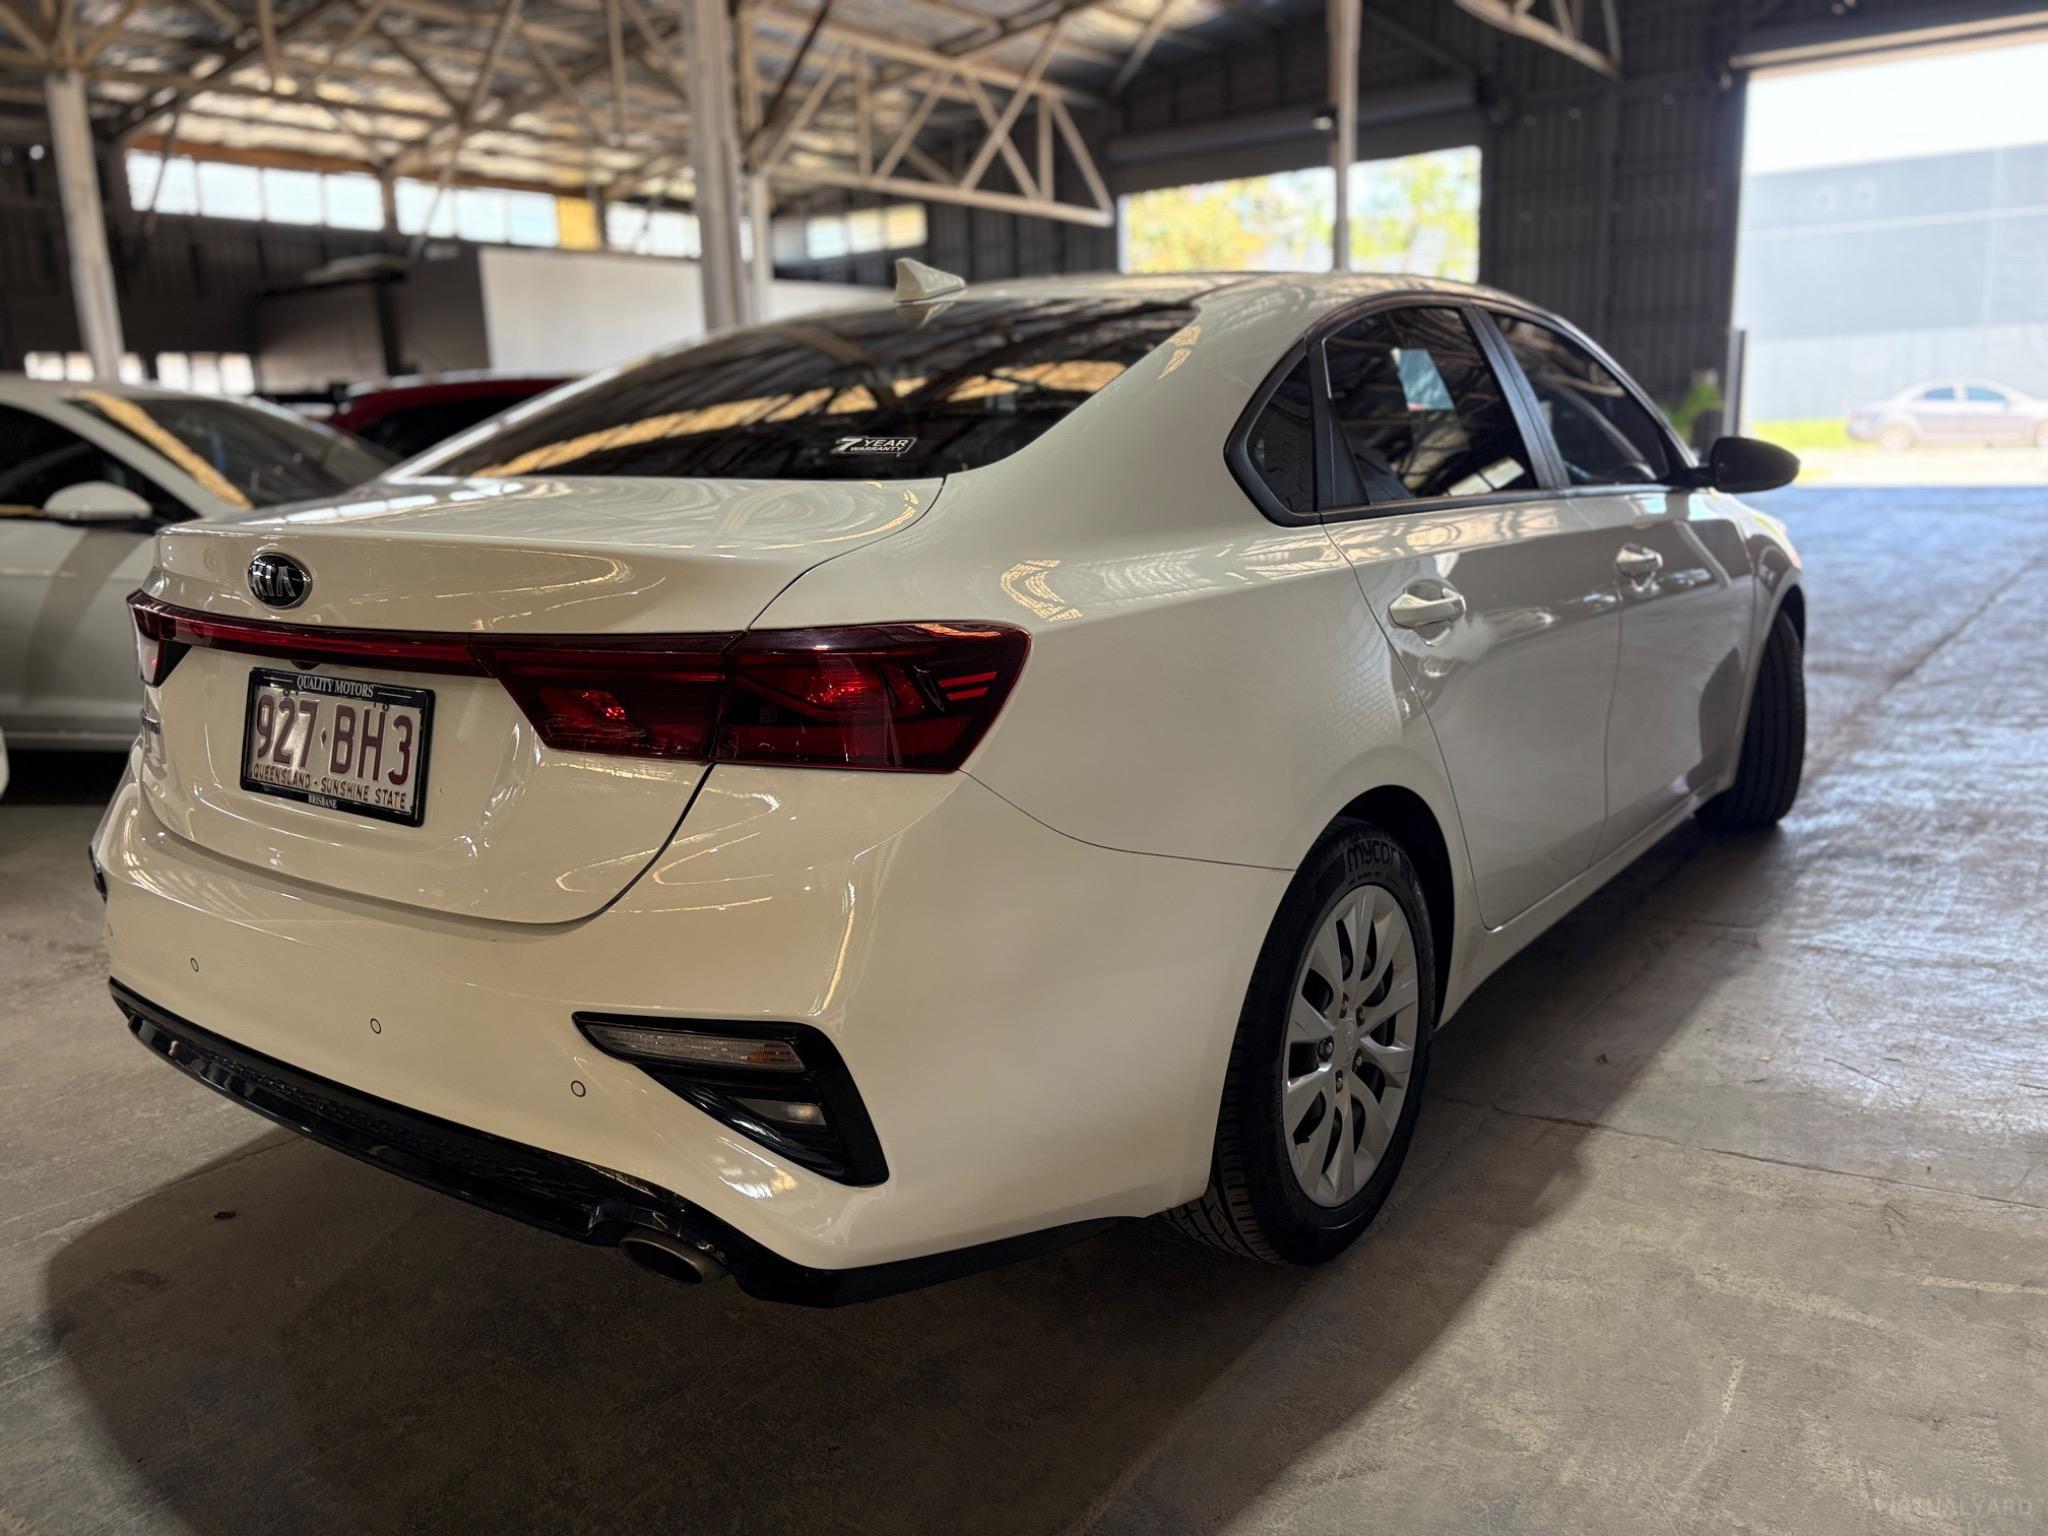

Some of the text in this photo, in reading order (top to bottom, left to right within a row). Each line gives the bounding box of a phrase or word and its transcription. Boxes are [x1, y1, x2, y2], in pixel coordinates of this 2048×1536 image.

[833, 437, 863, 453] 7
[251, 559, 297, 597] KIA
[297, 675, 374, 698] QUALITY MOTORS
[253, 763, 311, 789] QUEENSLAND
[320, 776, 369, 801] SUNSHINE
[375, 788, 407, 809] STATE
